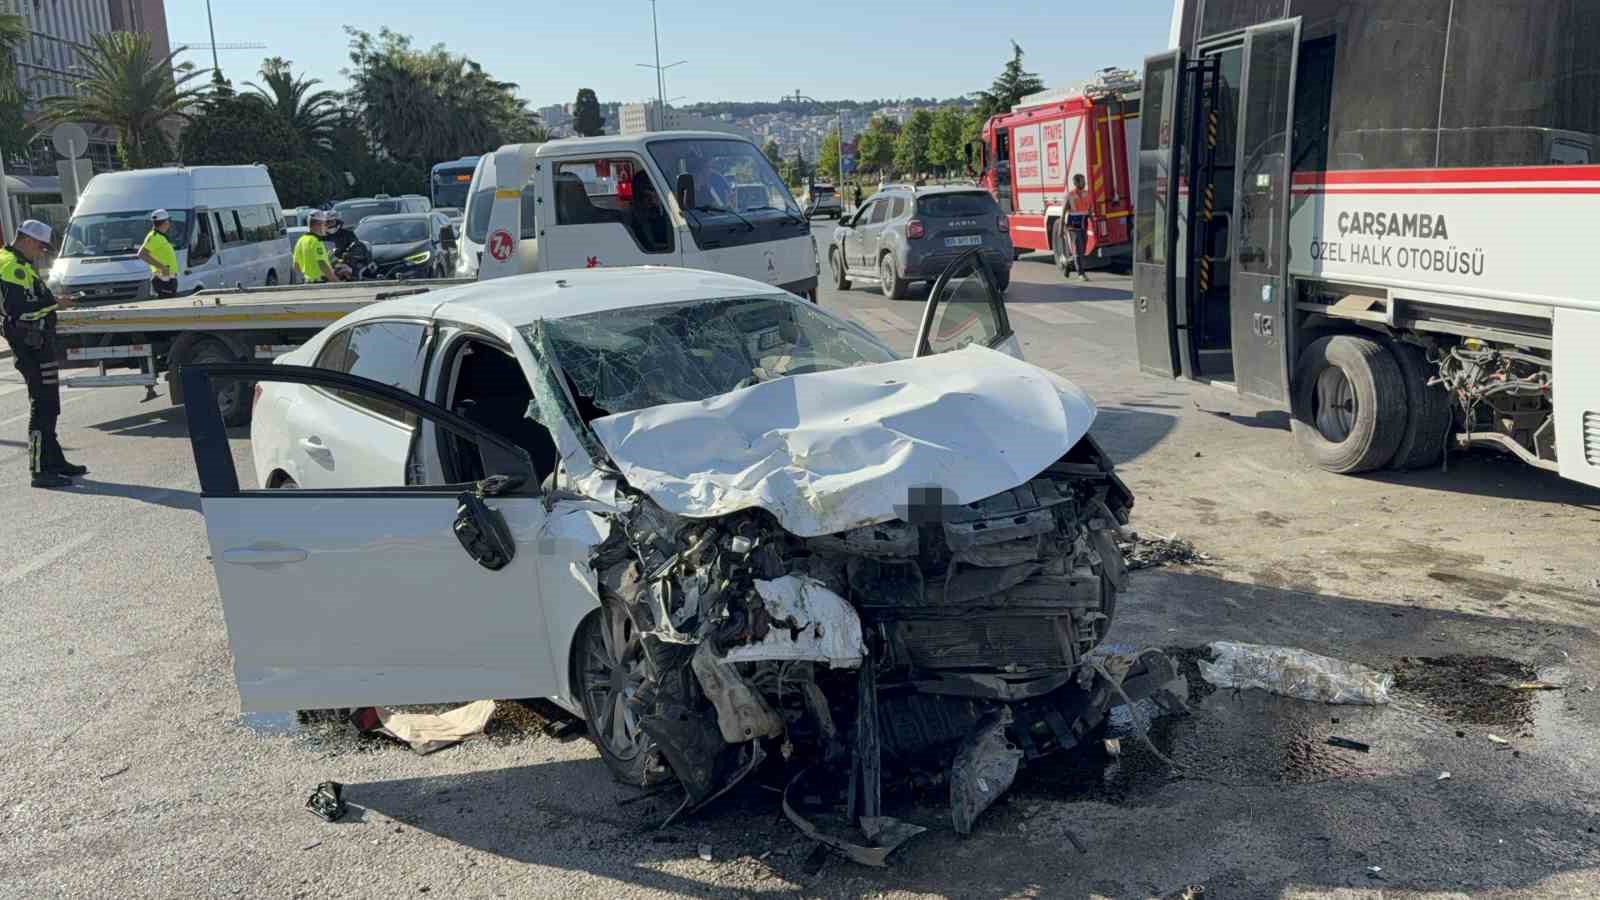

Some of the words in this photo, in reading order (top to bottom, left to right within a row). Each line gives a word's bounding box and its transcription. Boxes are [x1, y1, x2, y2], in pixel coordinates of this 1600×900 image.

[1338, 211, 1448, 240] ÇARŞAMBA
[1310, 236, 1346, 263] ÖZEL
[1350, 243, 1392, 267] HALK
[1397, 246, 1485, 276] OTOBÜSÜ
